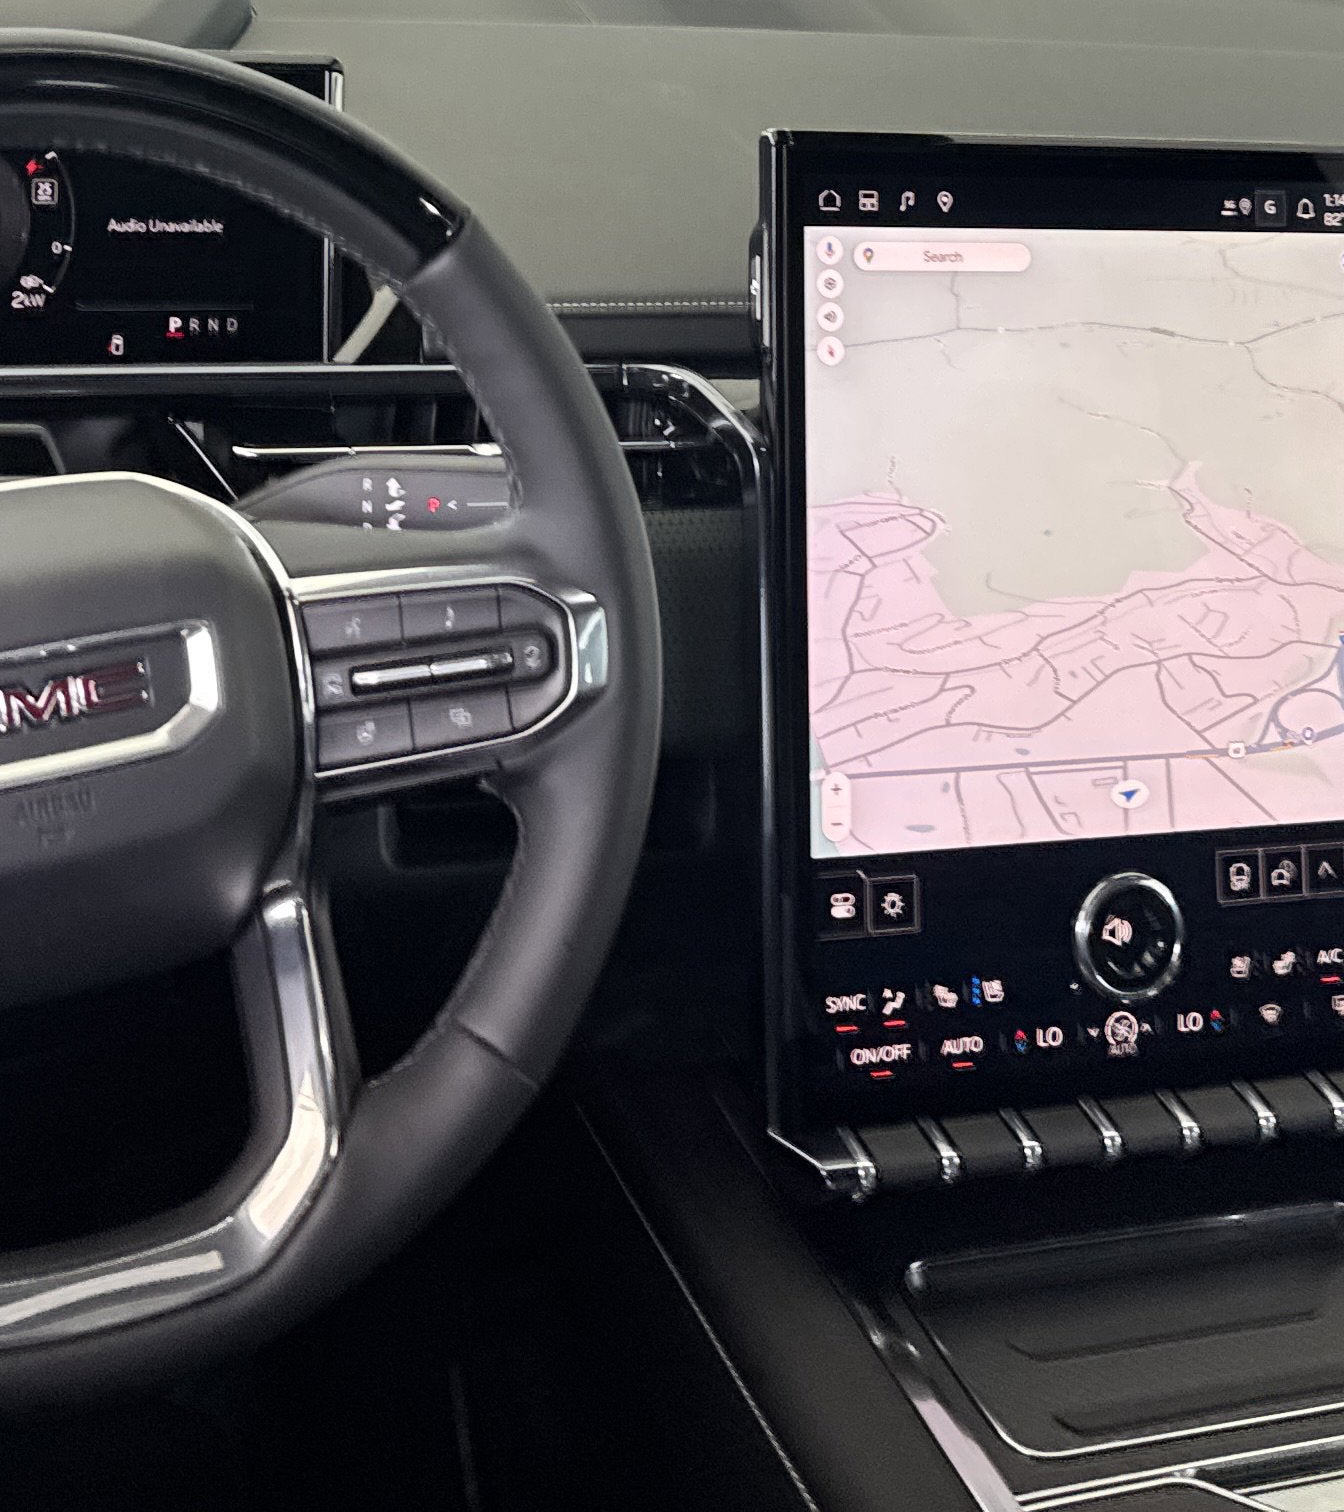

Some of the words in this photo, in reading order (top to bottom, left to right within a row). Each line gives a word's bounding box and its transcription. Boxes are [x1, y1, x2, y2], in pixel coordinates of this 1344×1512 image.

[107, 217, 147, 233] Audio
[148, 217, 224, 234] Unavailable
[922, 250, 965, 264] Search
[11, 290, 47, 309] 2kW
[168, 316, 183, 333] P
[189, 317, 201, 333] R
[208, 317, 220, 333] N
[226, 317, 239, 332] D
[1317, 947, 1344, 965] A/C
[825, 993, 867, 1014] SYNC
[1176, 1011, 1204, 1032] LO
[941, 1036, 984, 1056] AUTO
[1036, 1026, 1064, 1047] LO
[850, 1043, 912, 1065] ON/OFF
